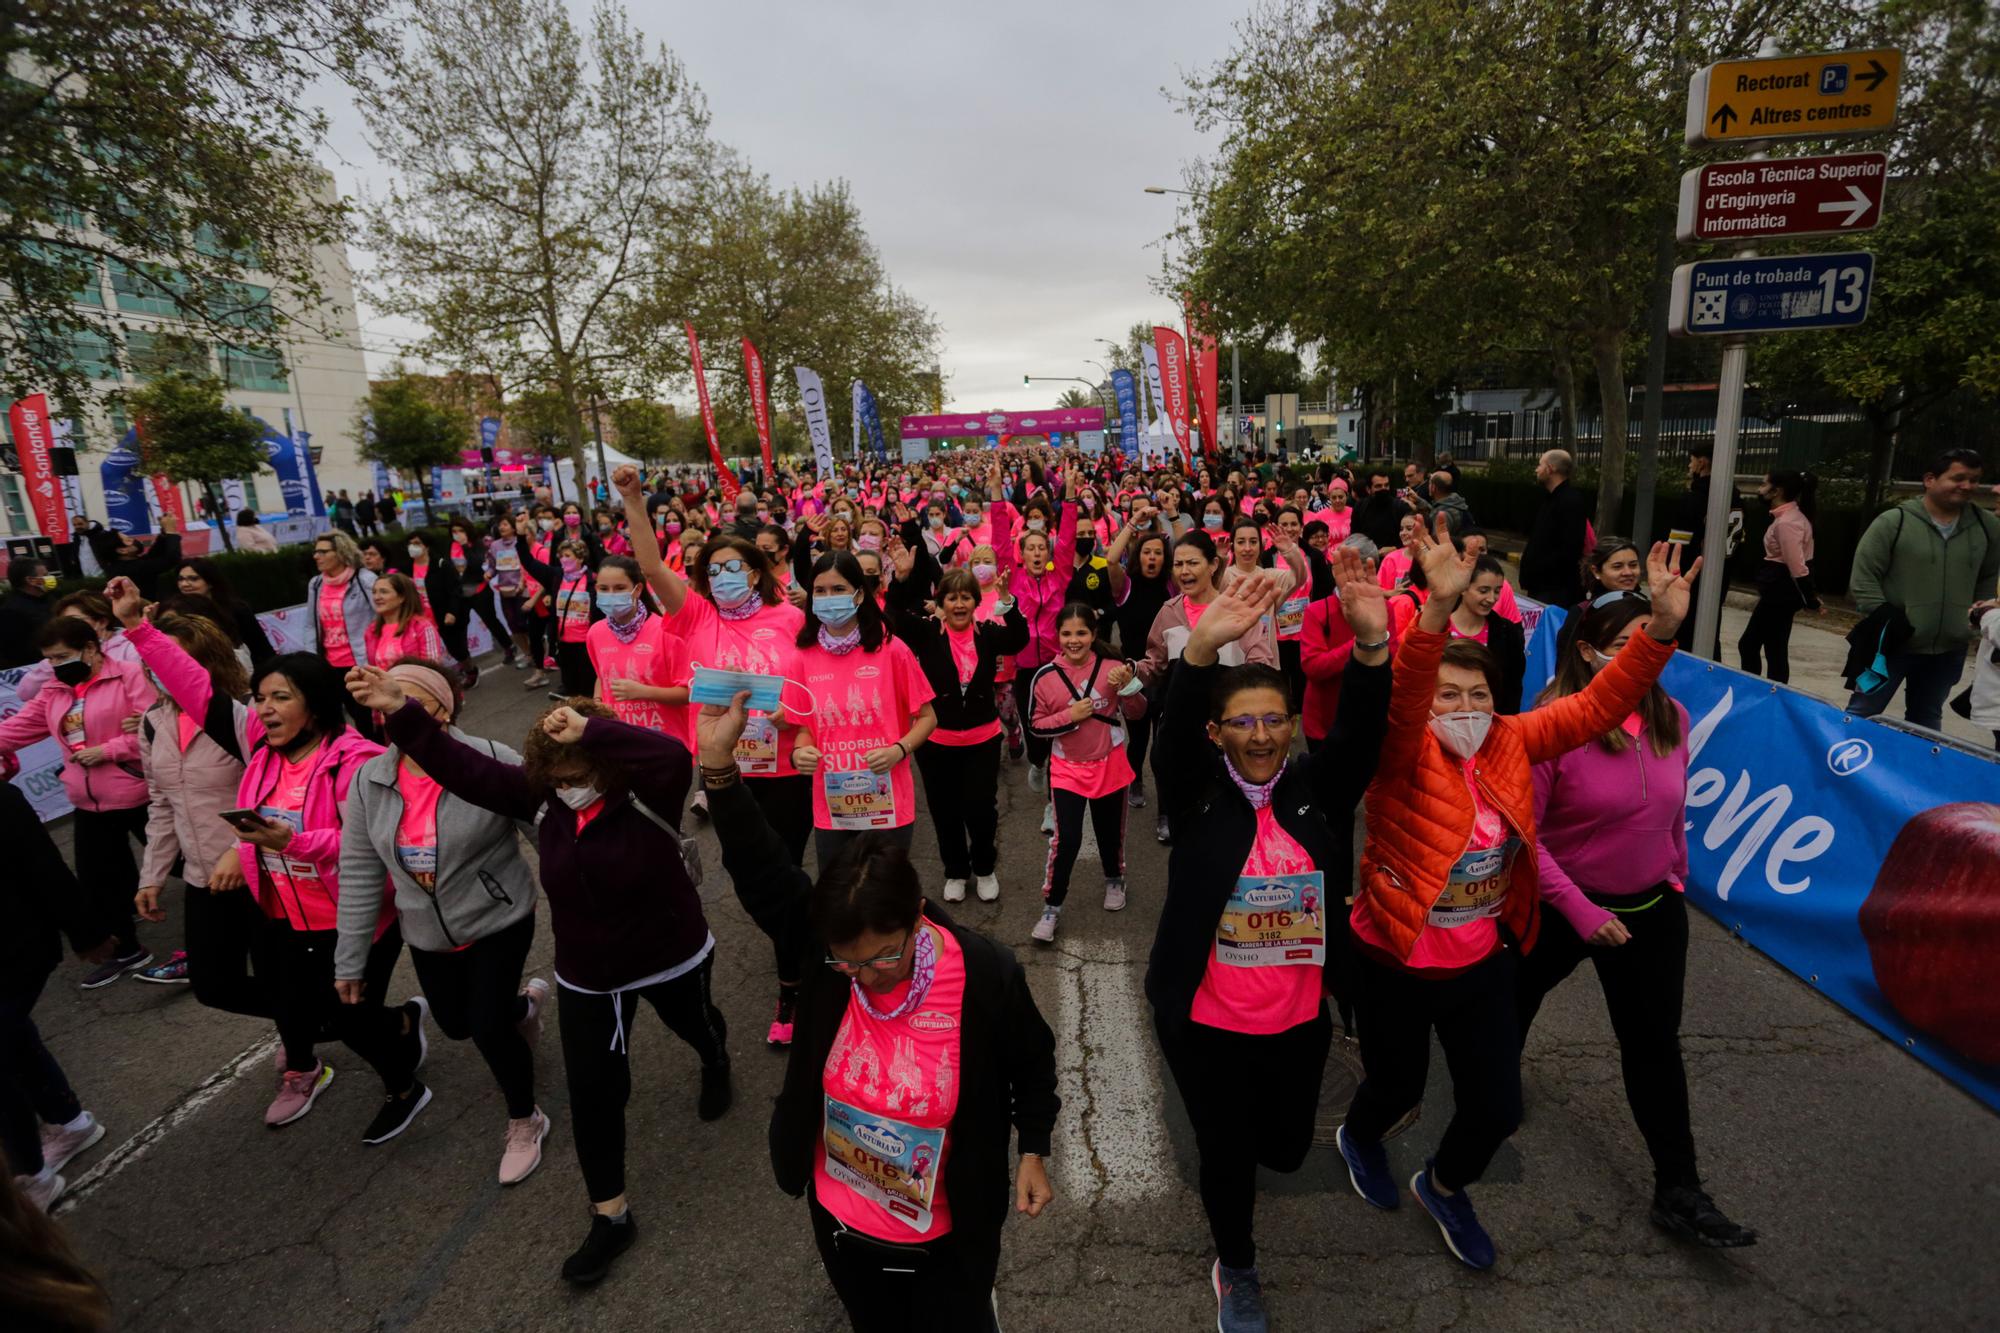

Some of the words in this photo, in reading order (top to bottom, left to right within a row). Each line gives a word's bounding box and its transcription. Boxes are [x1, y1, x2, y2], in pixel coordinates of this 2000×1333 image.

[1736, 71, 1810, 93] Rectorat
[1750, 107, 1801, 126] Altres
[1807, 103, 1872, 121] centres
[1707, 170, 1755, 187] Escola
[1760, 166, 1815, 184] Tècnica
[1819, 161, 1882, 181] Superior
[1703, 213, 1787, 232] Informàtica
[1696, 271, 1729, 287] Punt
[1733, 269, 1751, 285] de
[1755, 267, 1812, 284] trobada
[1818, 266, 1865, 315] 13
[22, 407, 52, 479] Santander
[839, 738, 889, 751] DORSAL
[844, 793, 872, 806] 016
[1465, 874, 1498, 895] 016
[1248, 893, 1291, 902] ASTURIANA
[1247, 911, 1292, 929] 016
[1258, 931, 1281, 940] 3182
[1225, 951, 1259, 961] OYSHO
[856, 1128, 901, 1154] ASTURIANA
[854, 1147, 898, 1178] 016
